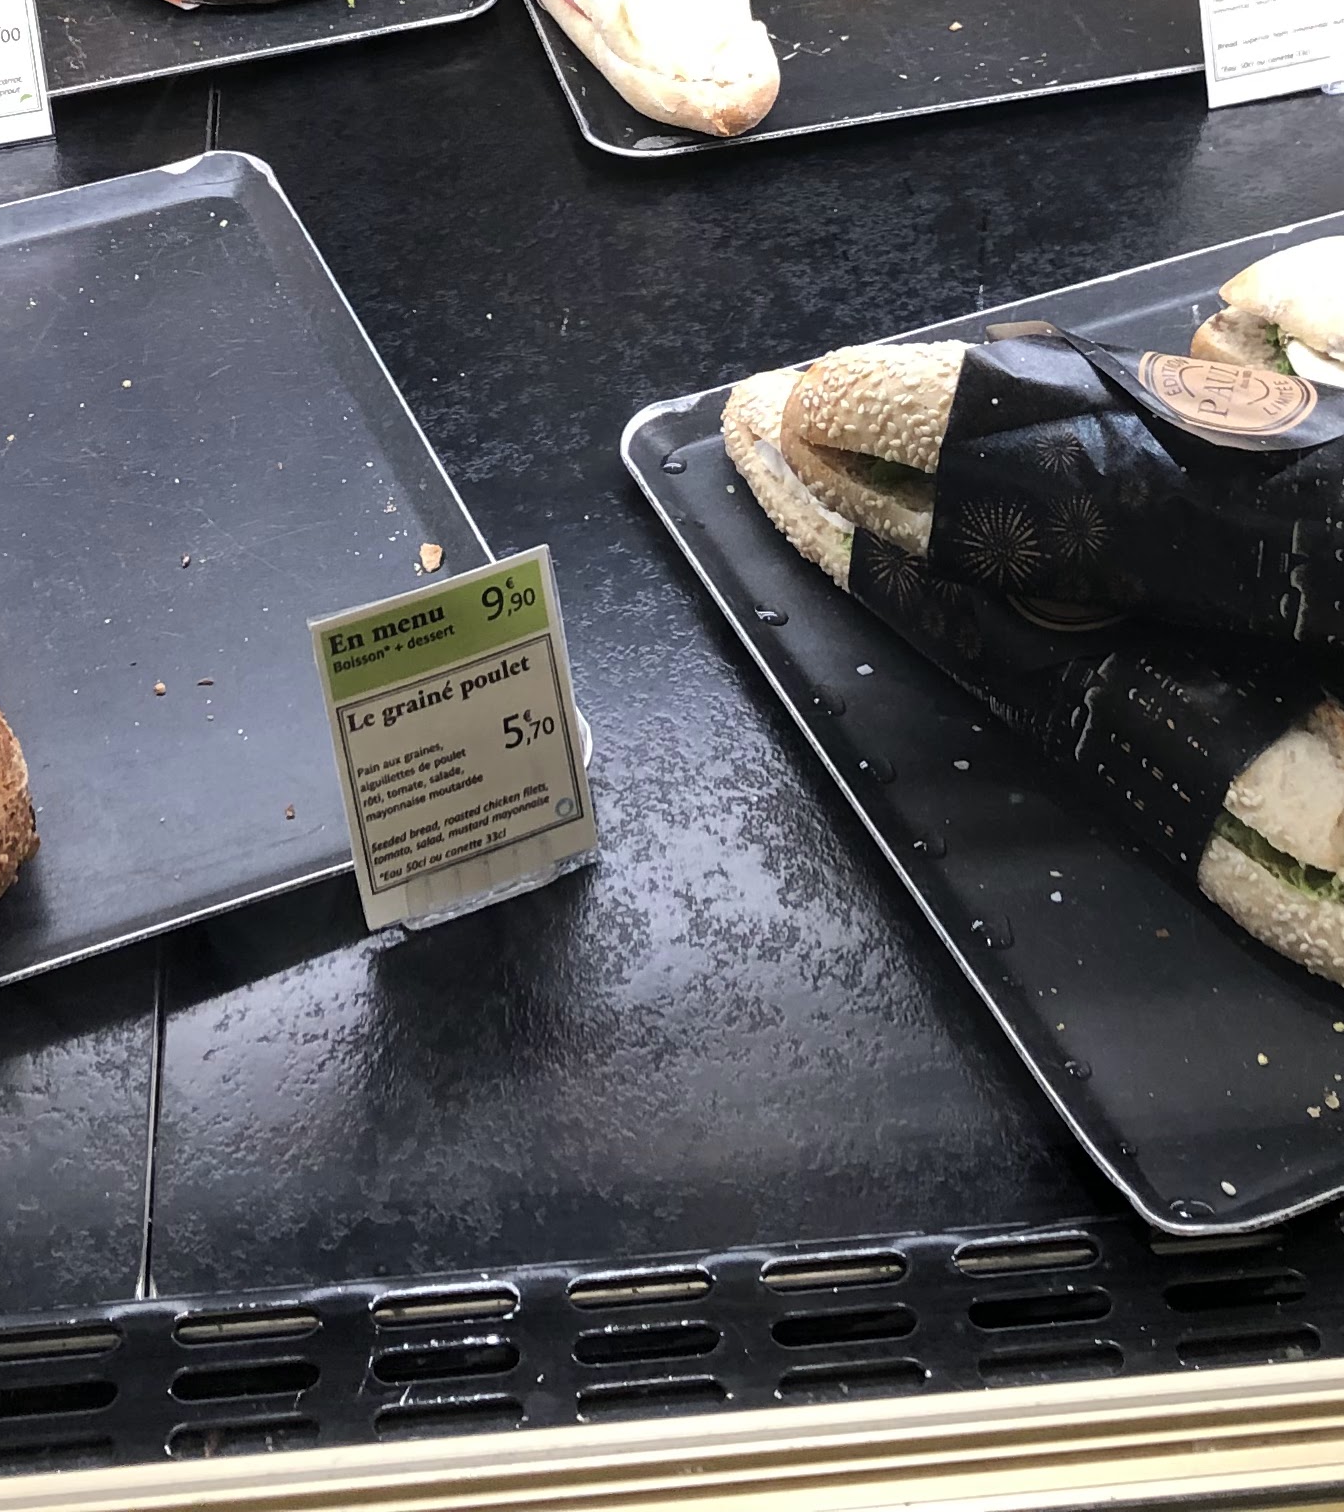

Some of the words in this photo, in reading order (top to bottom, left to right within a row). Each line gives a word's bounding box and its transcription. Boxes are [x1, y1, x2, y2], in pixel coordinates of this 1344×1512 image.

[1198, 365, 1240, 418] PAUL
[328, 630, 364, 657] En
[371, 604, 446, 643] menu
[407, 624, 455, 650] dessert
[347, 712, 375, 733] Le
[382, 681, 454, 729] grainé
[461, 655, 530, 701] poulet
[357, 762, 380, 779] Pain
[383, 756, 401, 770] aux
[404, 741, 444, 766] graines,
[359, 766, 416, 794] aiguillettes
[419, 760, 432, 773] de
[434, 748, 466, 771] poulet
[363, 792, 384, 808] rôti,
[387, 780, 426, 800] tomate,
[429, 767, 465, 789] salade,
[366, 794, 427, 823] mayonnaise
[429, 773, 484, 801] moutardée
